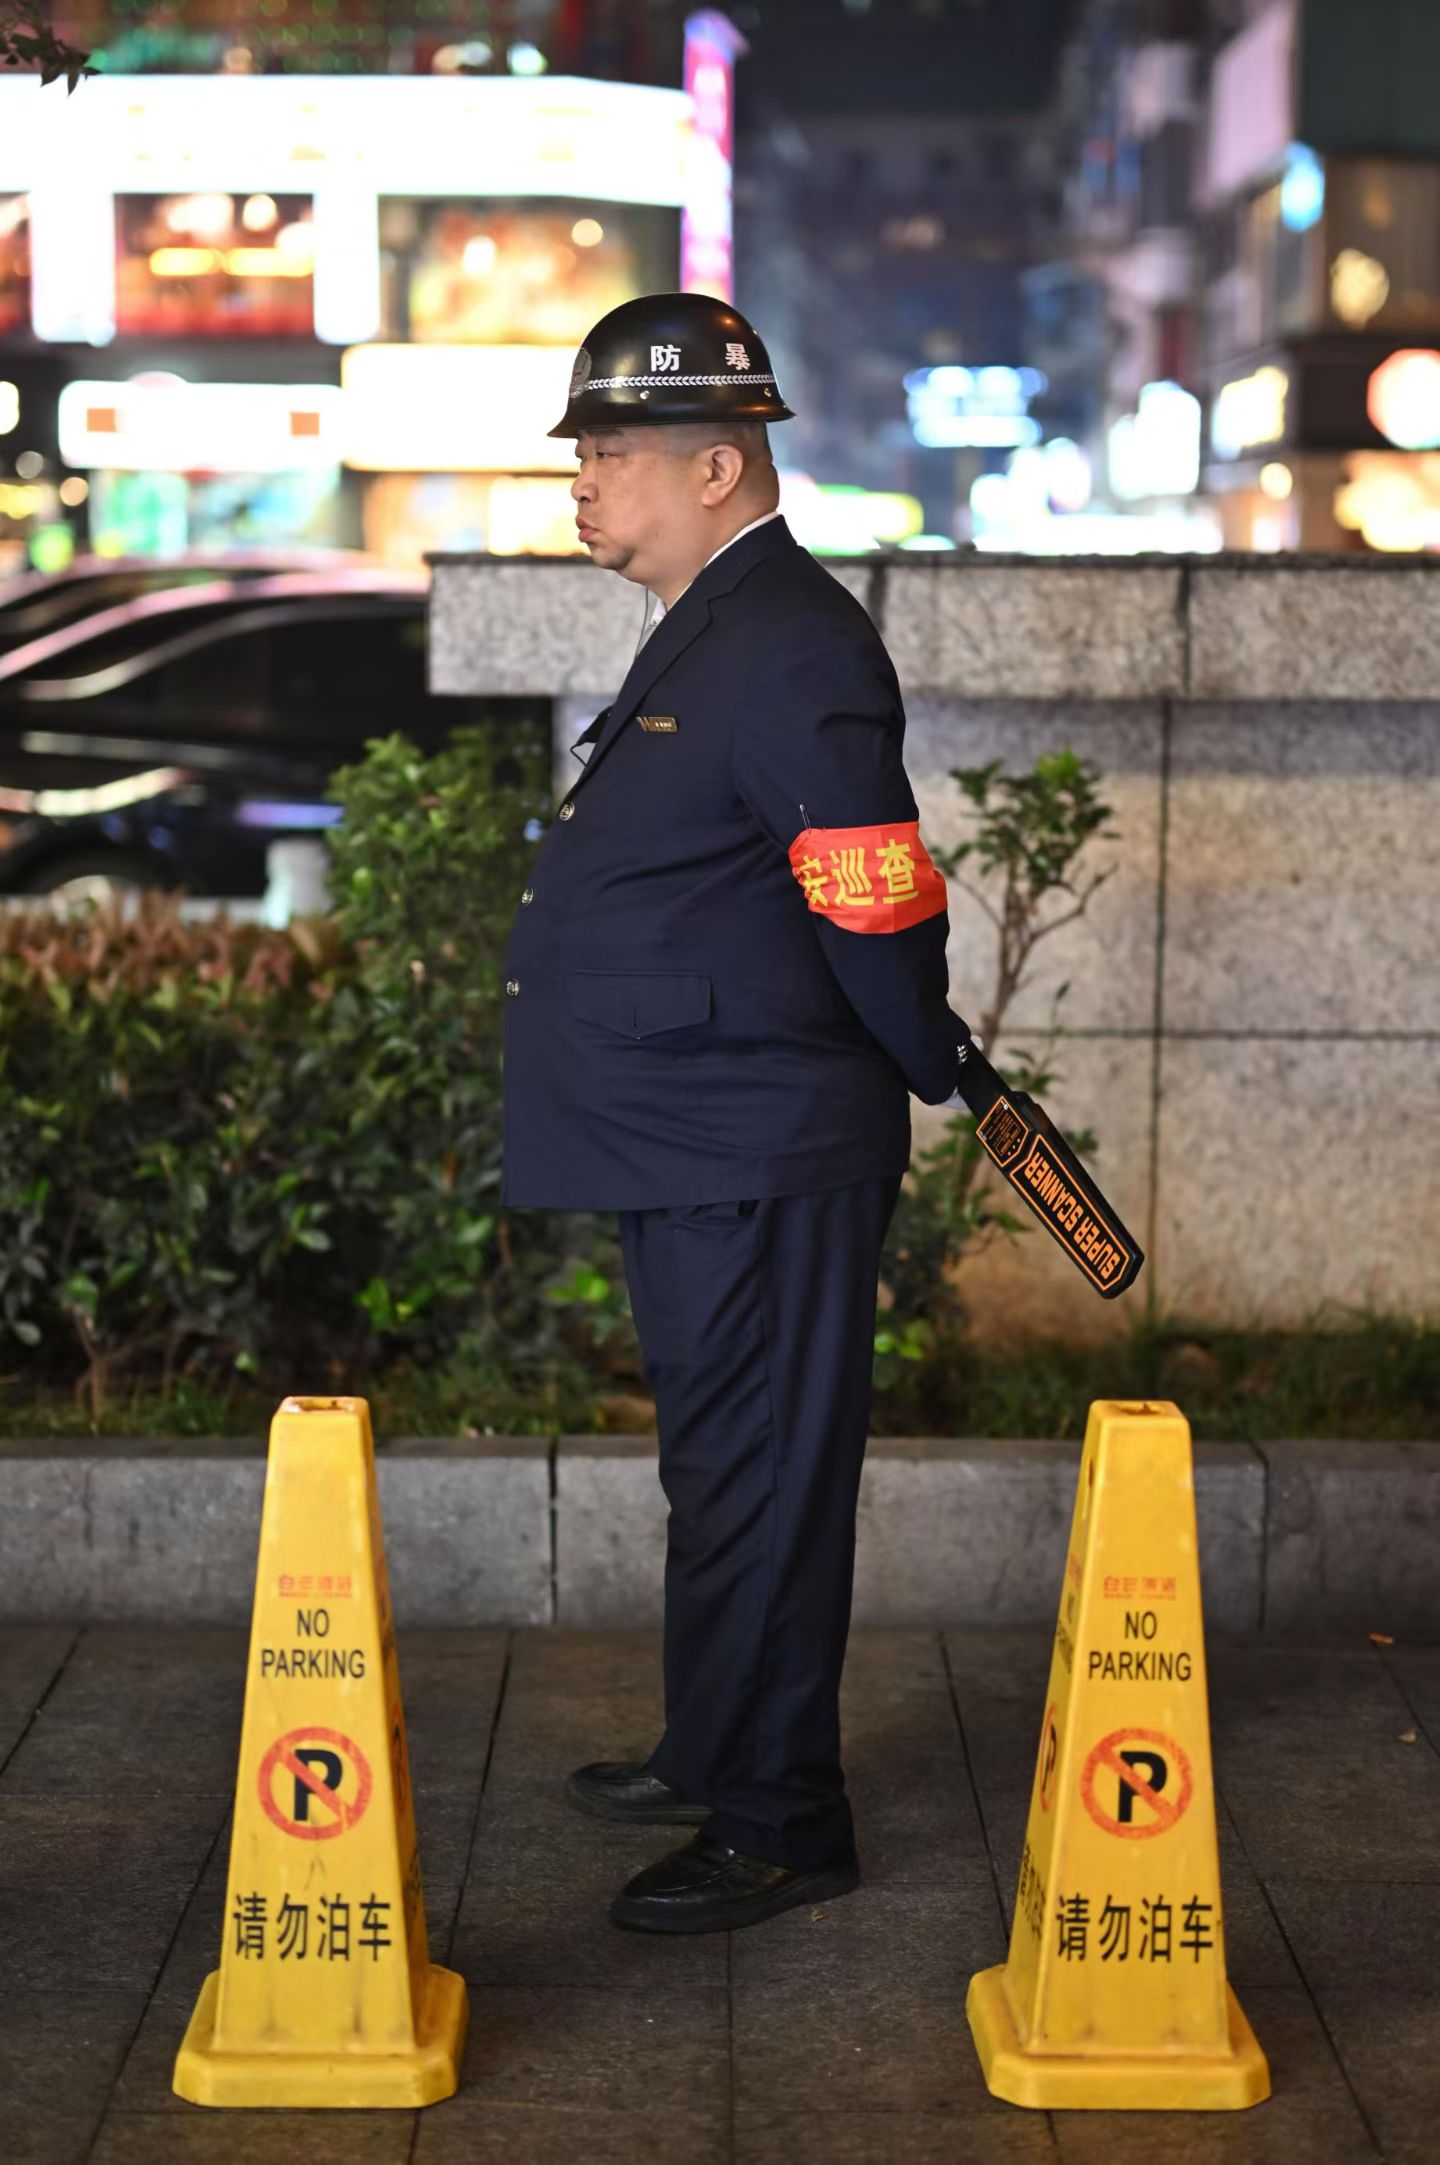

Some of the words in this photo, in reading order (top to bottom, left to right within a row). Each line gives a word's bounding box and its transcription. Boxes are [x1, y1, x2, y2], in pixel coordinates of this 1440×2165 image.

[650, 345, 681, 372] 防
[725, 343, 750, 371] 暴
[1024, 1152, 1084, 1232] SCANNER
[1073, 1216, 1120, 1279] SUPER
[297, 1609, 330, 1637] NO
[1124, 1611, 1158, 1640] NO
[261, 1648, 365, 1679] PARKING
[1089, 1651, 1191, 1682] PARKING
[233, 1891, 391, 1961] 请勿泊车
[1056, 1893, 1213, 1963] 请勿泊车
